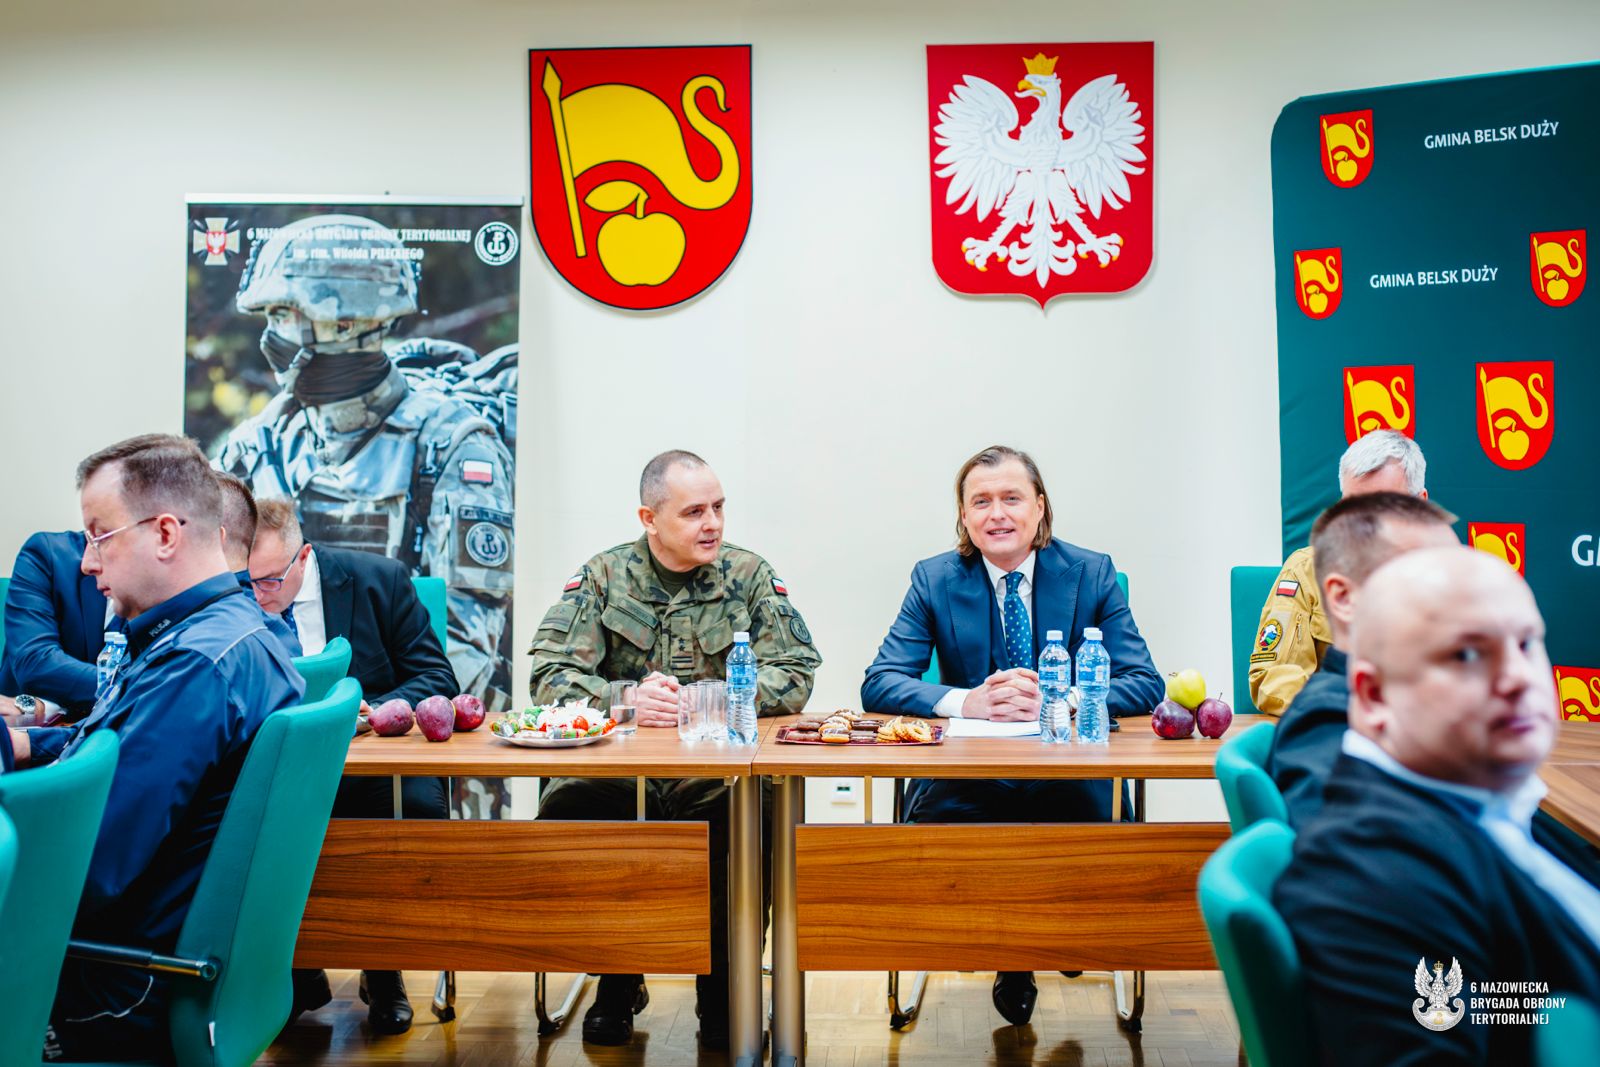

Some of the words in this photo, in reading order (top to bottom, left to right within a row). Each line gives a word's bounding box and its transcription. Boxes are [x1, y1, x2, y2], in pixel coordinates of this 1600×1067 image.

[1424, 132, 1472, 149] GMINA
[1474, 126, 1518, 144] BELSK
[1520, 119, 1560, 139] DUŻY
[247, 227, 255, 240] 6
[401, 228, 472, 243] TERYTORIALNEJ
[371, 248, 424, 260] PILECKIEGO
[1369, 273, 1415, 289] GMINA
[1417, 270, 1459, 286] BELSK
[1461, 264, 1498, 283] DUŻY
[1571, 534, 1600, 567] G
